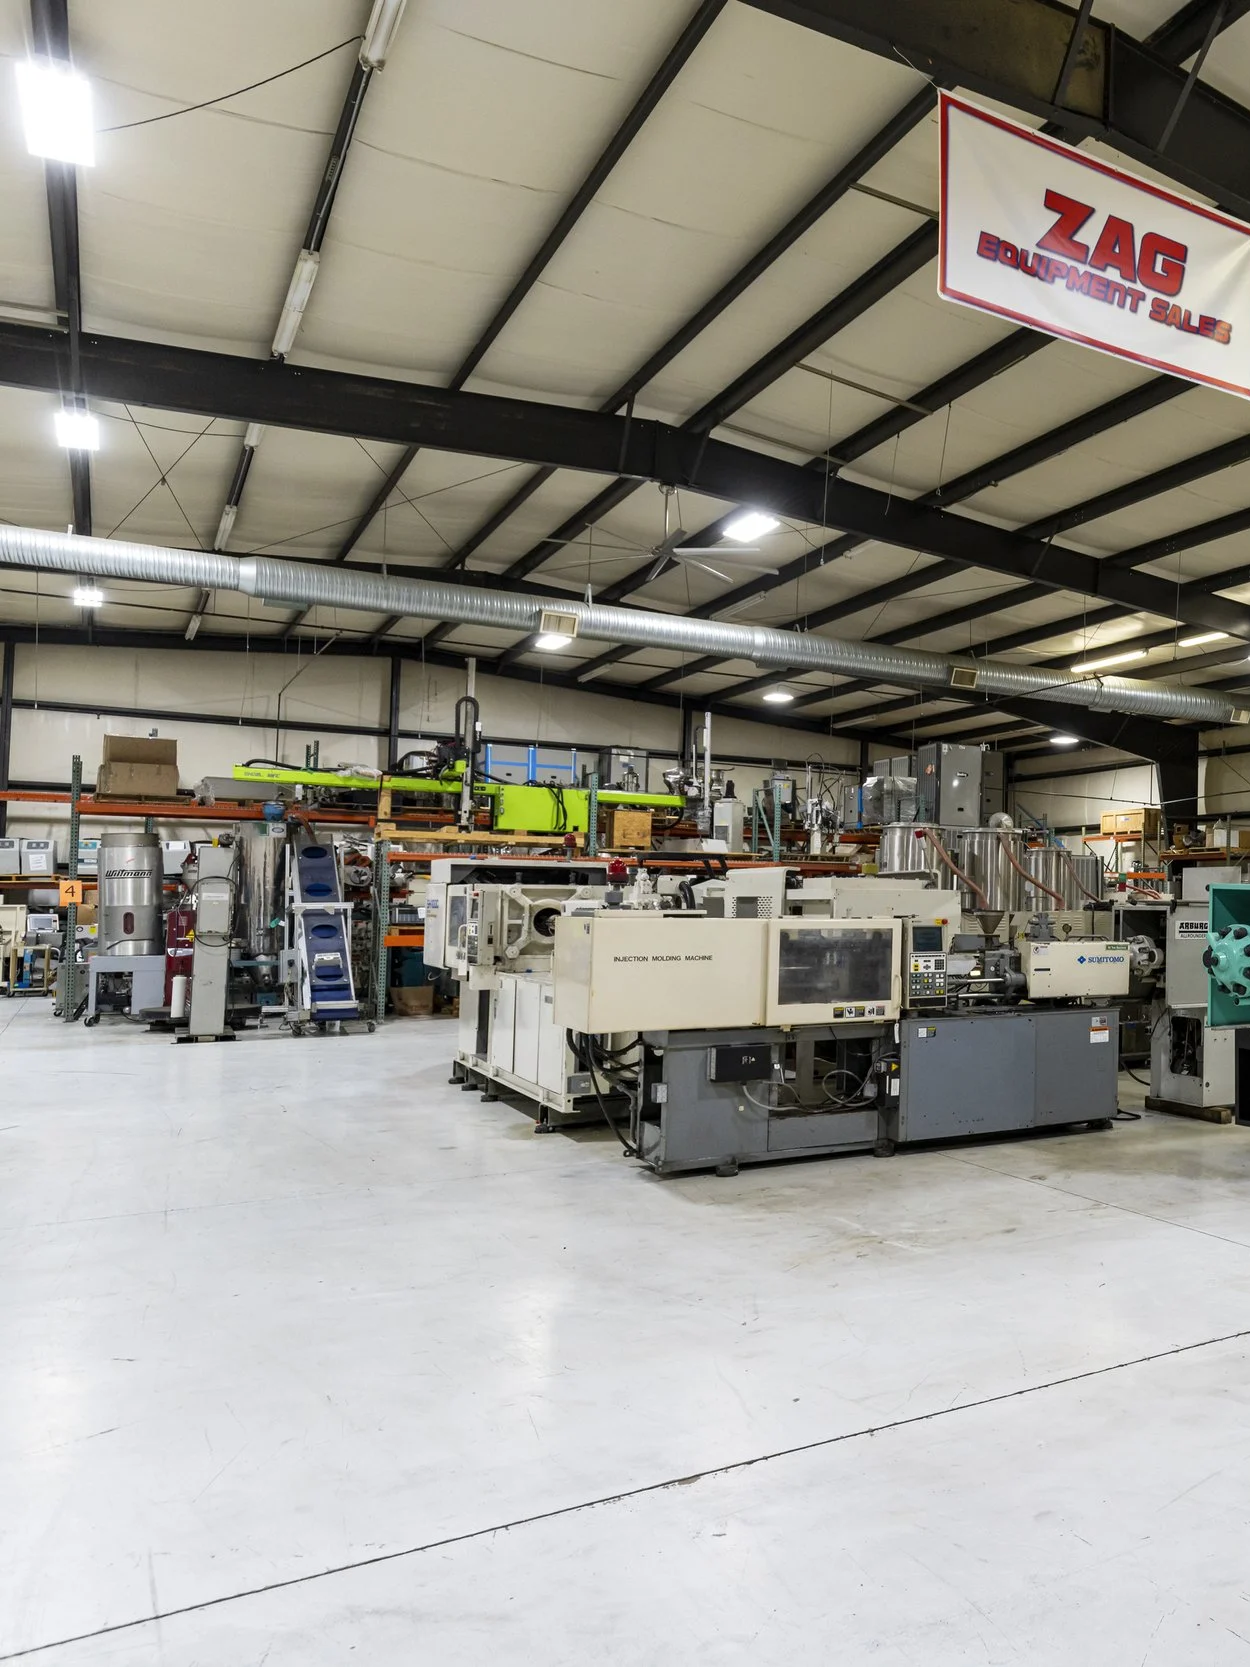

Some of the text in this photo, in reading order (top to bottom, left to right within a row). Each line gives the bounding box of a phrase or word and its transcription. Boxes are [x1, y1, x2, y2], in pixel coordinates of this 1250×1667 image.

[1036, 188, 1188, 297] ZAG
[976, 230, 1233, 345] EQUIPMENT SALES
[105, 869, 152, 879] Wittmann
[64, 885, 76, 897] 4
[1179, 922, 1208, 930] ARBURG
